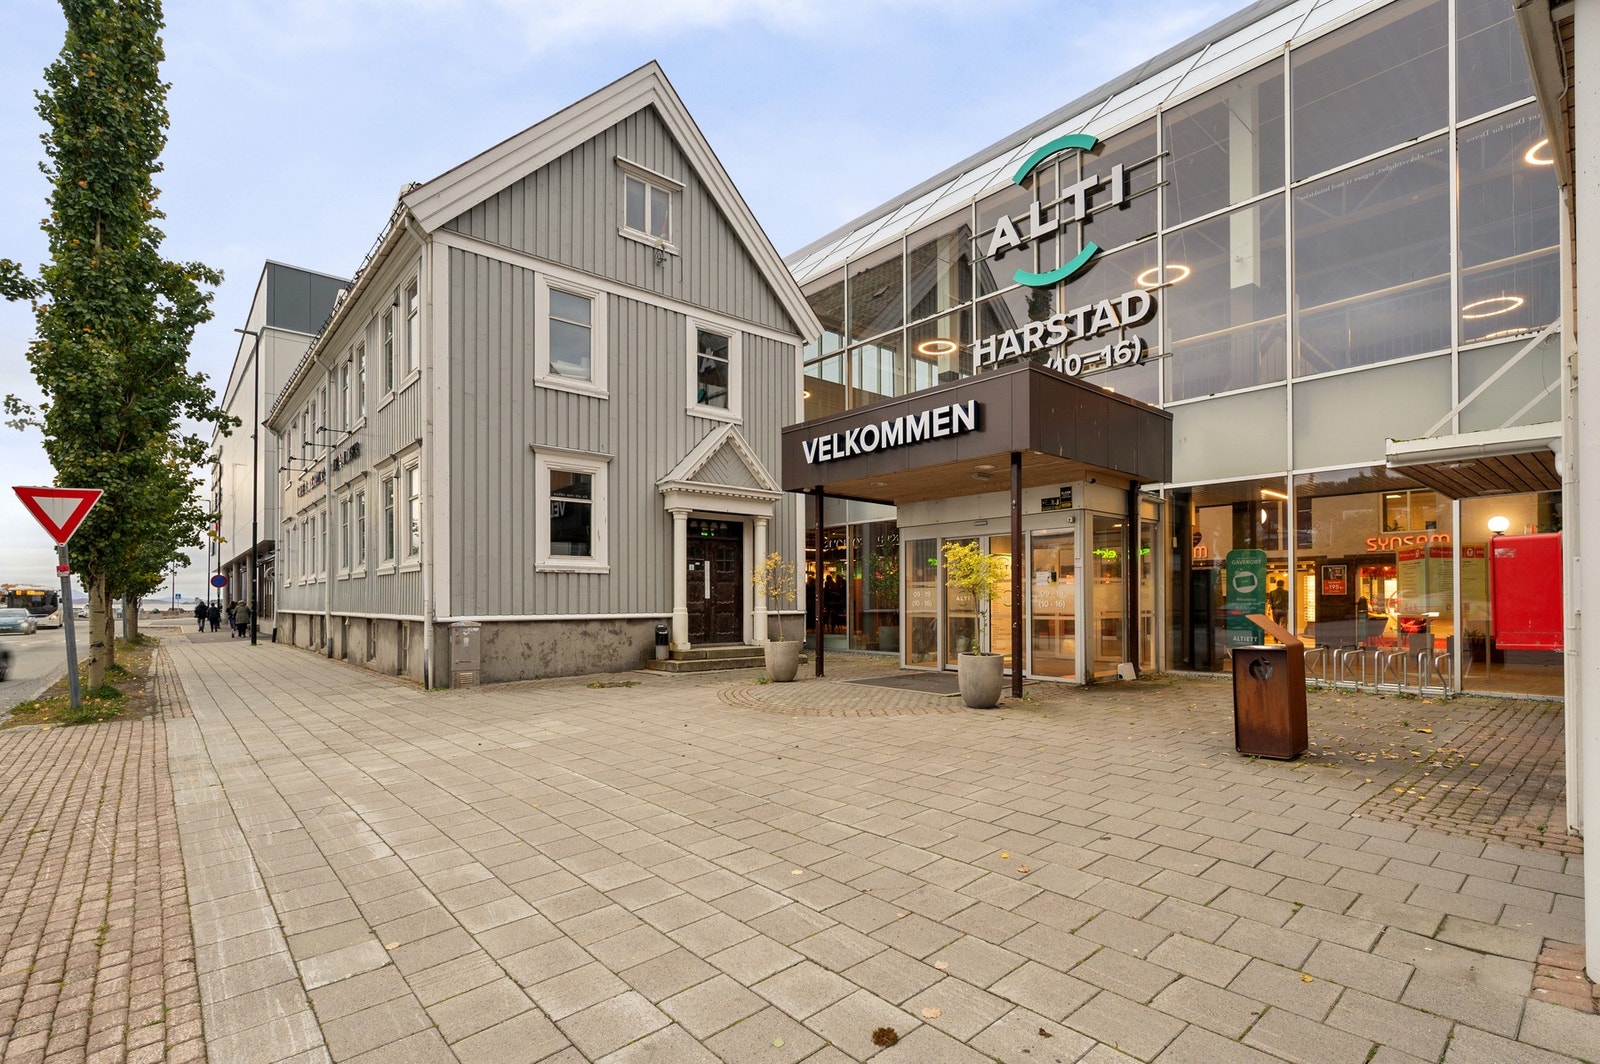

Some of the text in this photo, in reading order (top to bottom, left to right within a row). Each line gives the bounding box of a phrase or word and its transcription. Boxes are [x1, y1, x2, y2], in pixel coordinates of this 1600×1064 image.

[987, 163, 1124, 257] ALTI
[973, 289, 1152, 367] HARSTAD
[802, 399, 977, 465] VELKOMMEN
